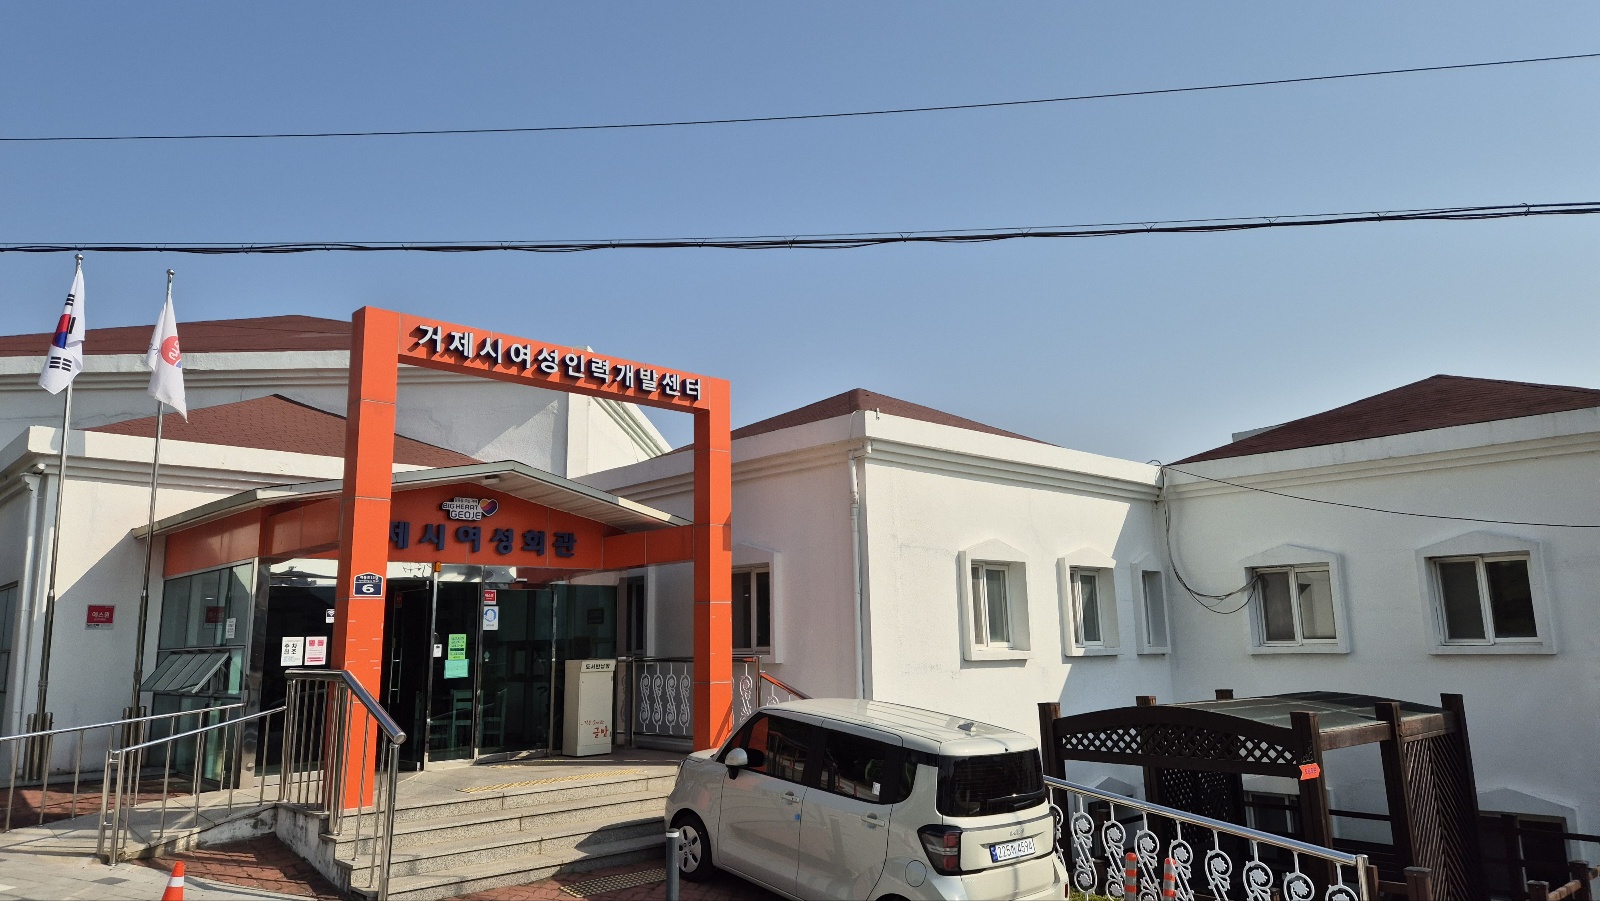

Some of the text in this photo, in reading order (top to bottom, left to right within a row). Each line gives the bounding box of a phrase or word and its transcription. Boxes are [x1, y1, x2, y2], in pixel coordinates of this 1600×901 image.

[417, 324, 701, 401] 거제시여성인력개발센터
[442, 502, 479, 511] BIG HEART
[450, 510, 481, 520] GEOJE
[362, 584, 375, 593] 6
